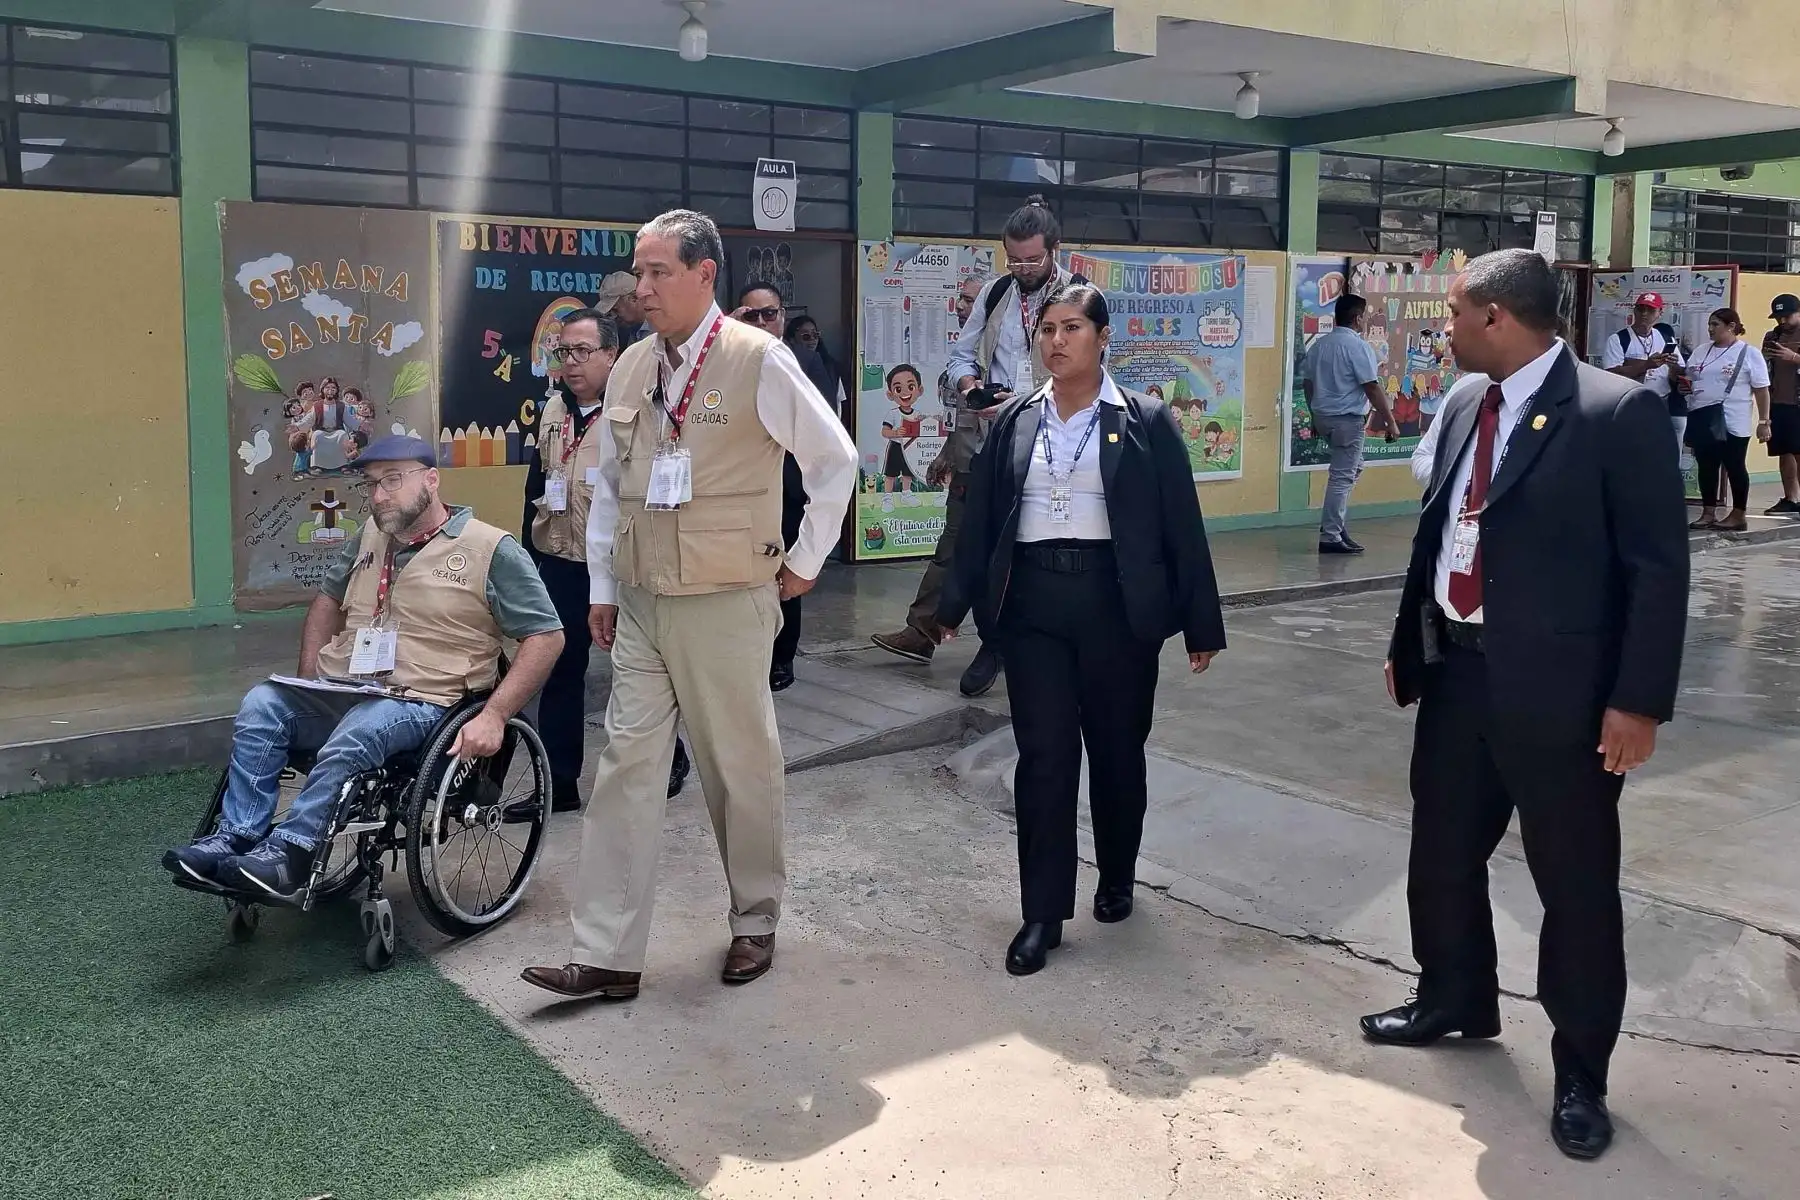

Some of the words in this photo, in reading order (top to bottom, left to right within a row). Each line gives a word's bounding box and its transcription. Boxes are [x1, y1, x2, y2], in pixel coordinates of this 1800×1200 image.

[762, 163, 788, 174] AULA
[459, 223, 637, 257] BIENVENID
[912, 254, 949, 266] 044650
[249, 258, 409, 310] SEMANA
[475, 267, 507, 291] DE
[1073, 260, 1232, 293] ¡BIENVENIDOS!
[1642, 274, 1681, 283] 044651
[1108, 299, 1125, 313] DE
[1127, 299, 1184, 314] REGRESO
[1185, 300, 1195, 314] A
[261, 313, 395, 360] SANTA
[1127, 316, 1182, 337] CLASES
[481, 329, 504, 358] 5
[916, 441, 942, 449] Rodrigo
[900, 519, 926, 533] futuro
